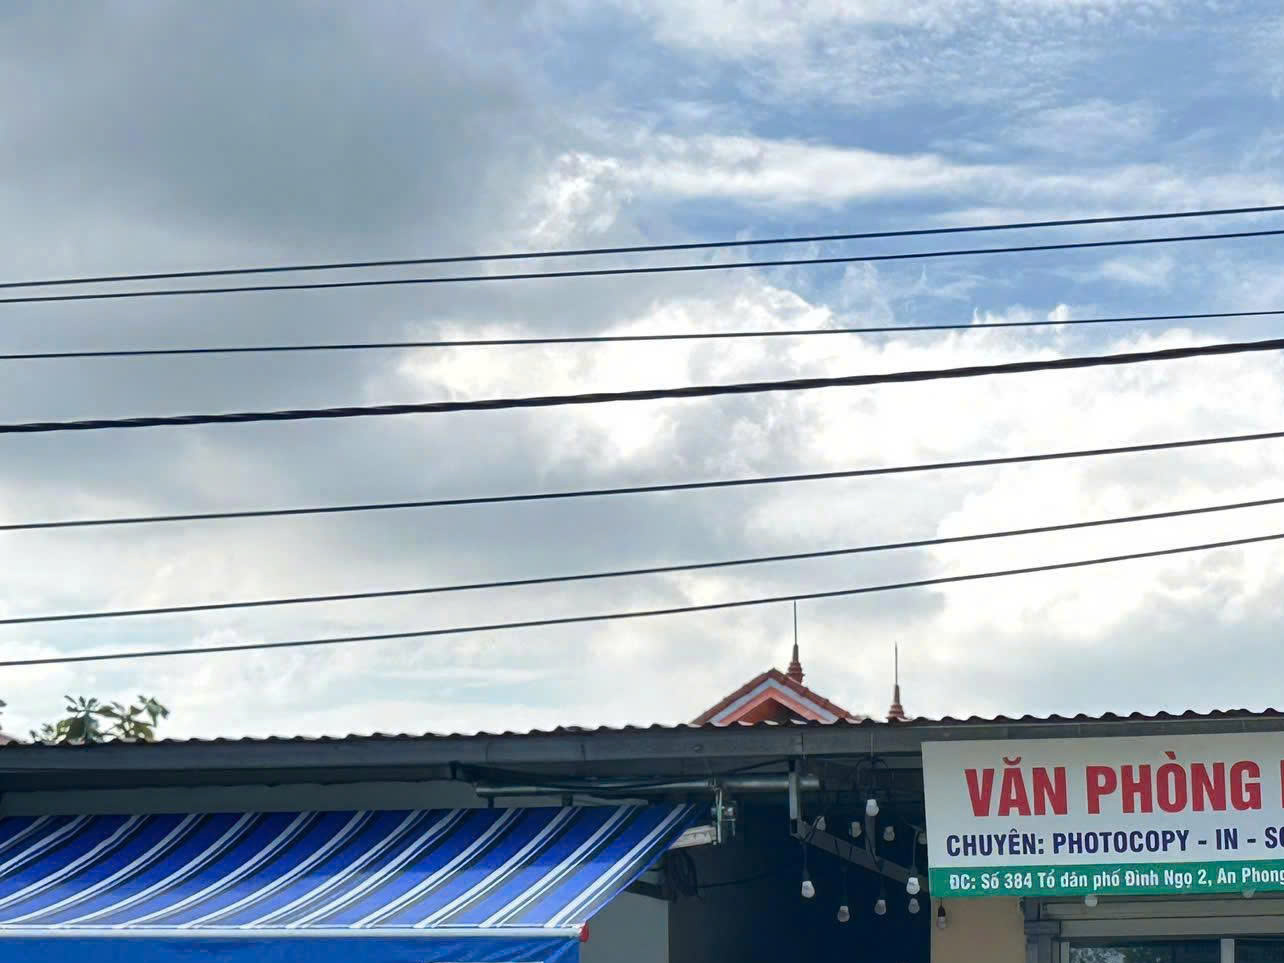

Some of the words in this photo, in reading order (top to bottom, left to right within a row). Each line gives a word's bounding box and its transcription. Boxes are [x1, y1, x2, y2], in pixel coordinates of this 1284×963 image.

[965, 756, 1069, 818] VĂN
[1086, 751, 1262, 815] PHÒNG
[947, 828, 1045, 857] CHUYÊN:
[1053, 829, 1190, 855] PHOTOCOPY
[1216, 828, 1238, 851] IN
[949, 872, 976, 890] ĐC:
[981, 869, 1000, 889] Số
[1003, 872, 1032, 889] 384
[1060, 871, 1088, 888] dân
[1093, 865, 1120, 891] phố
[1124, 868, 1159, 887] Đình
[1163, 869, 1193, 890] Ngọ
[1198, 869, 1212, 887] 2,
[1217, 869, 1236, 885] An
